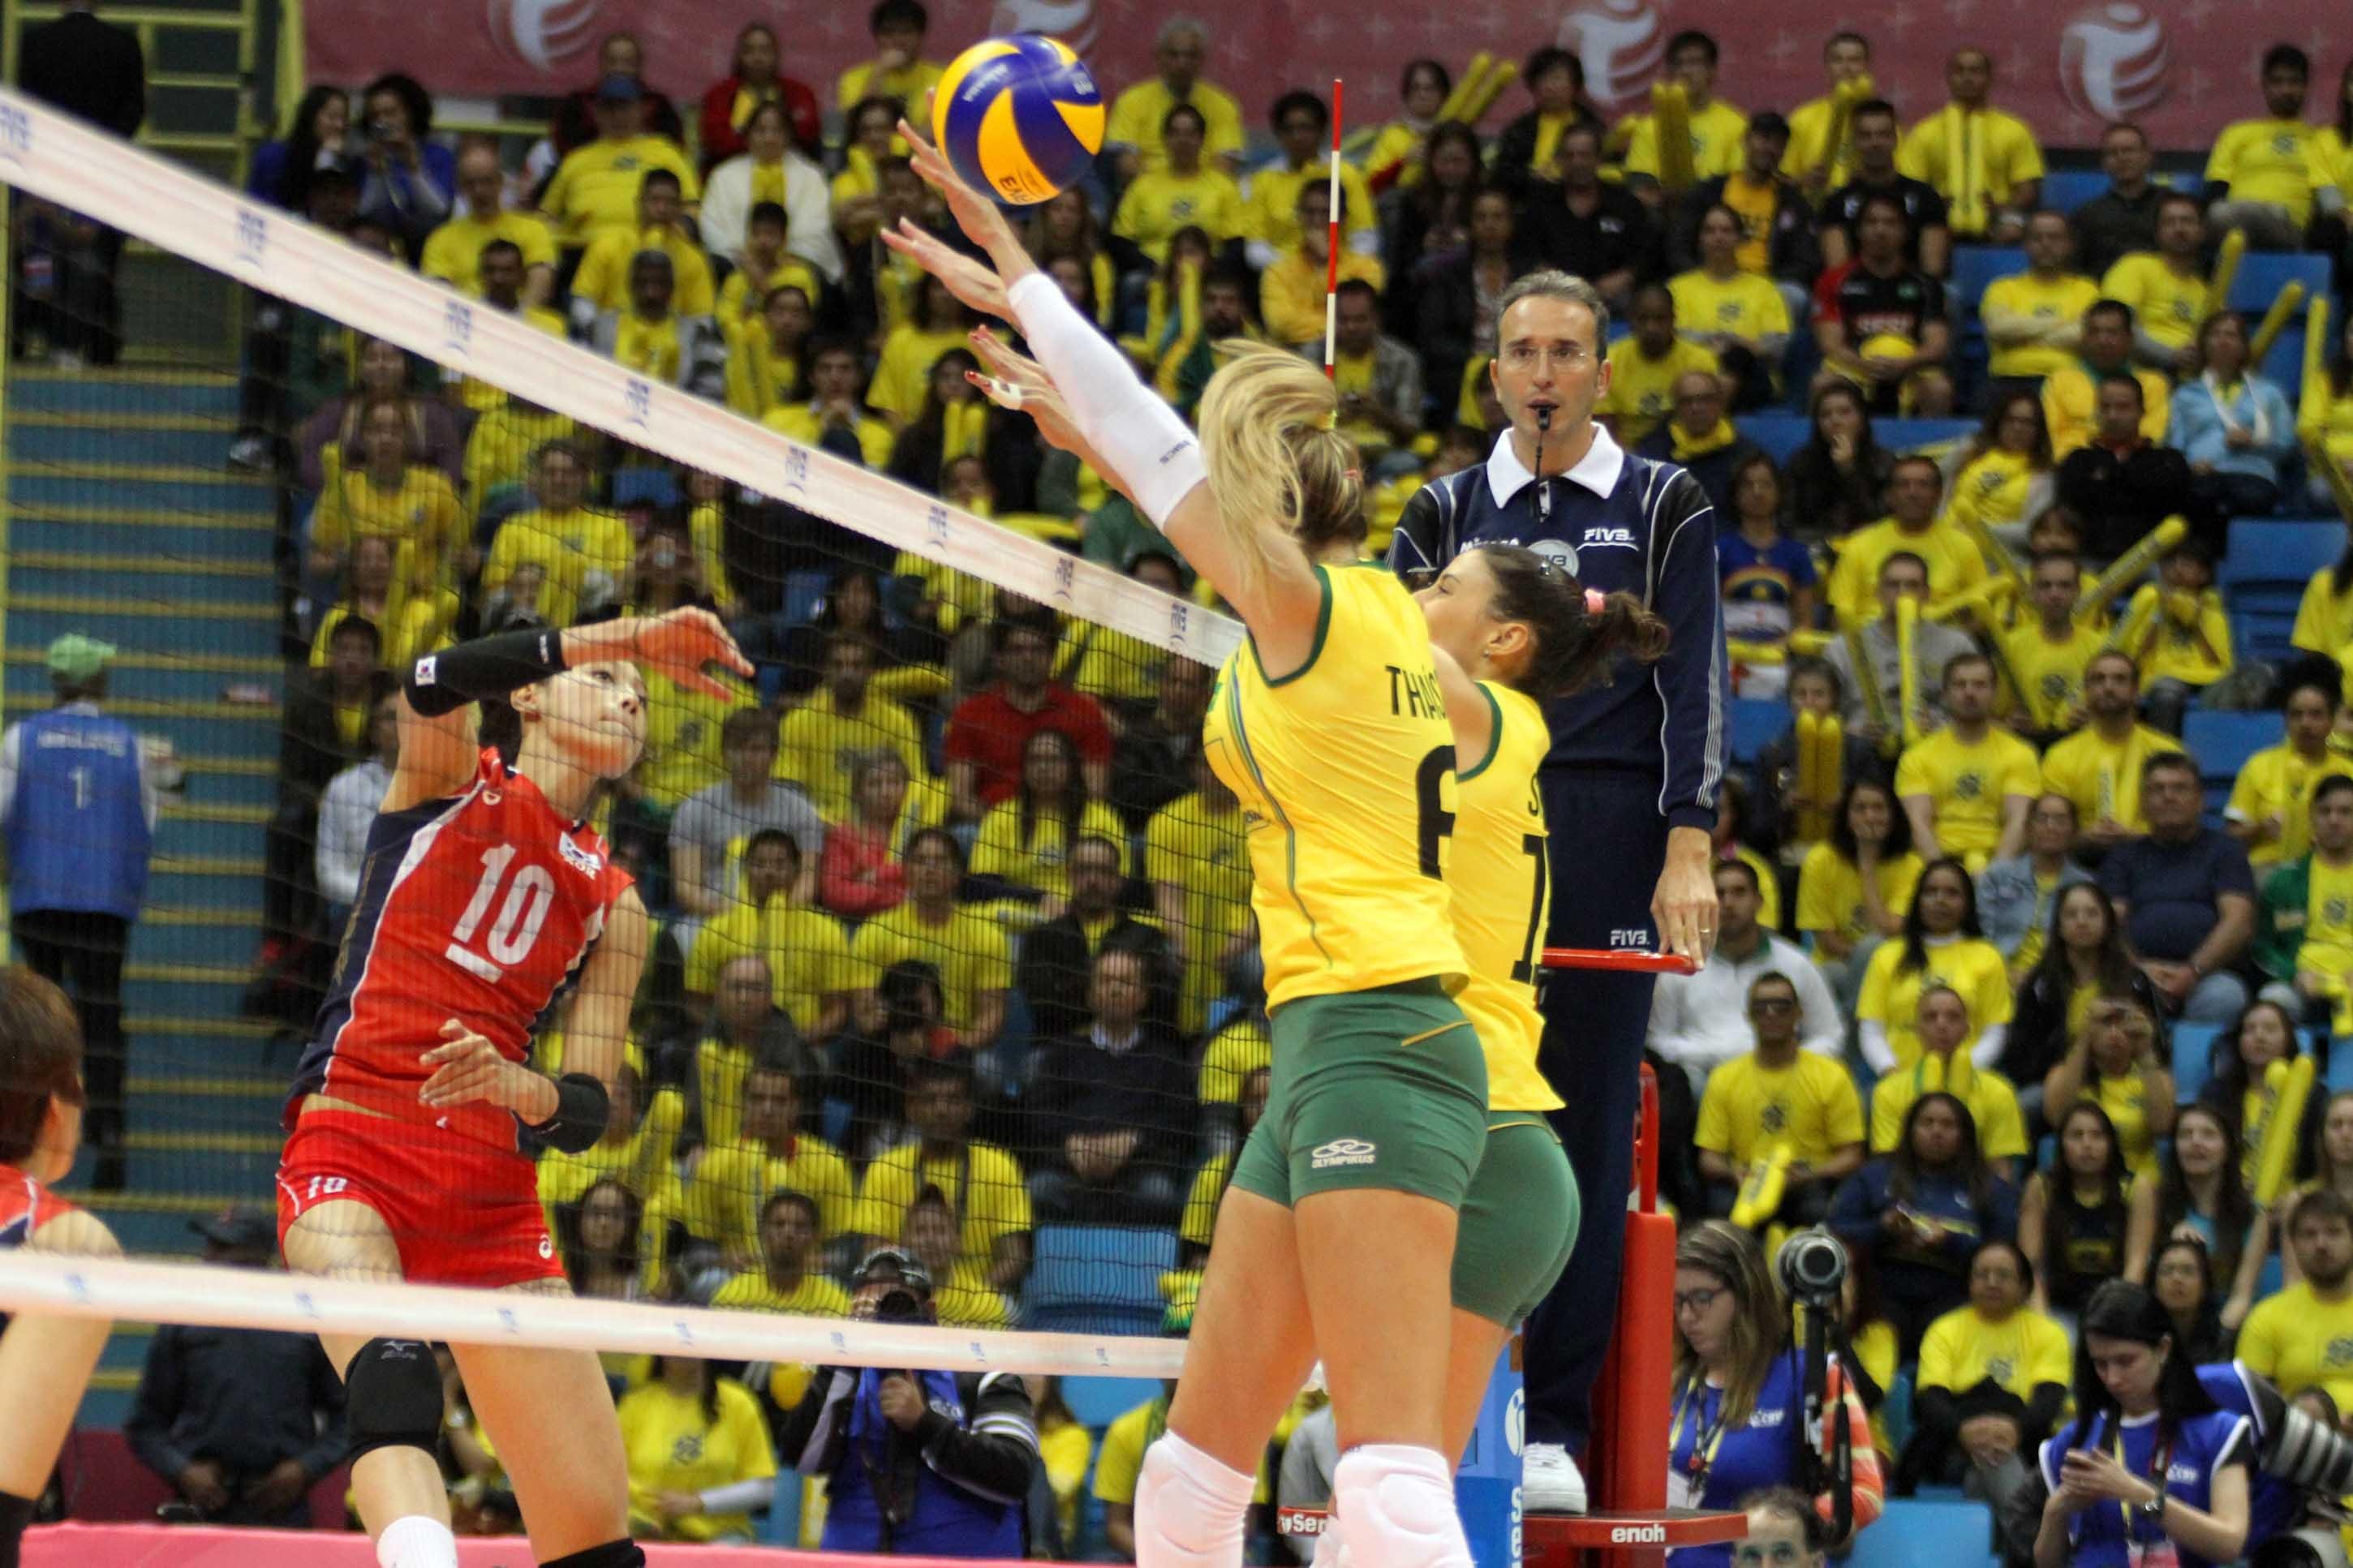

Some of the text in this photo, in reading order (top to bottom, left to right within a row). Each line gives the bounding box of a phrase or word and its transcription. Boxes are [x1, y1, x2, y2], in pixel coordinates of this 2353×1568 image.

[451, 843, 555, 965] 10
[1611, 930, 1647, 946] FIVB
[308, 1175, 347, 1200] 10
[1611, 1523, 1666, 1543] enoh
